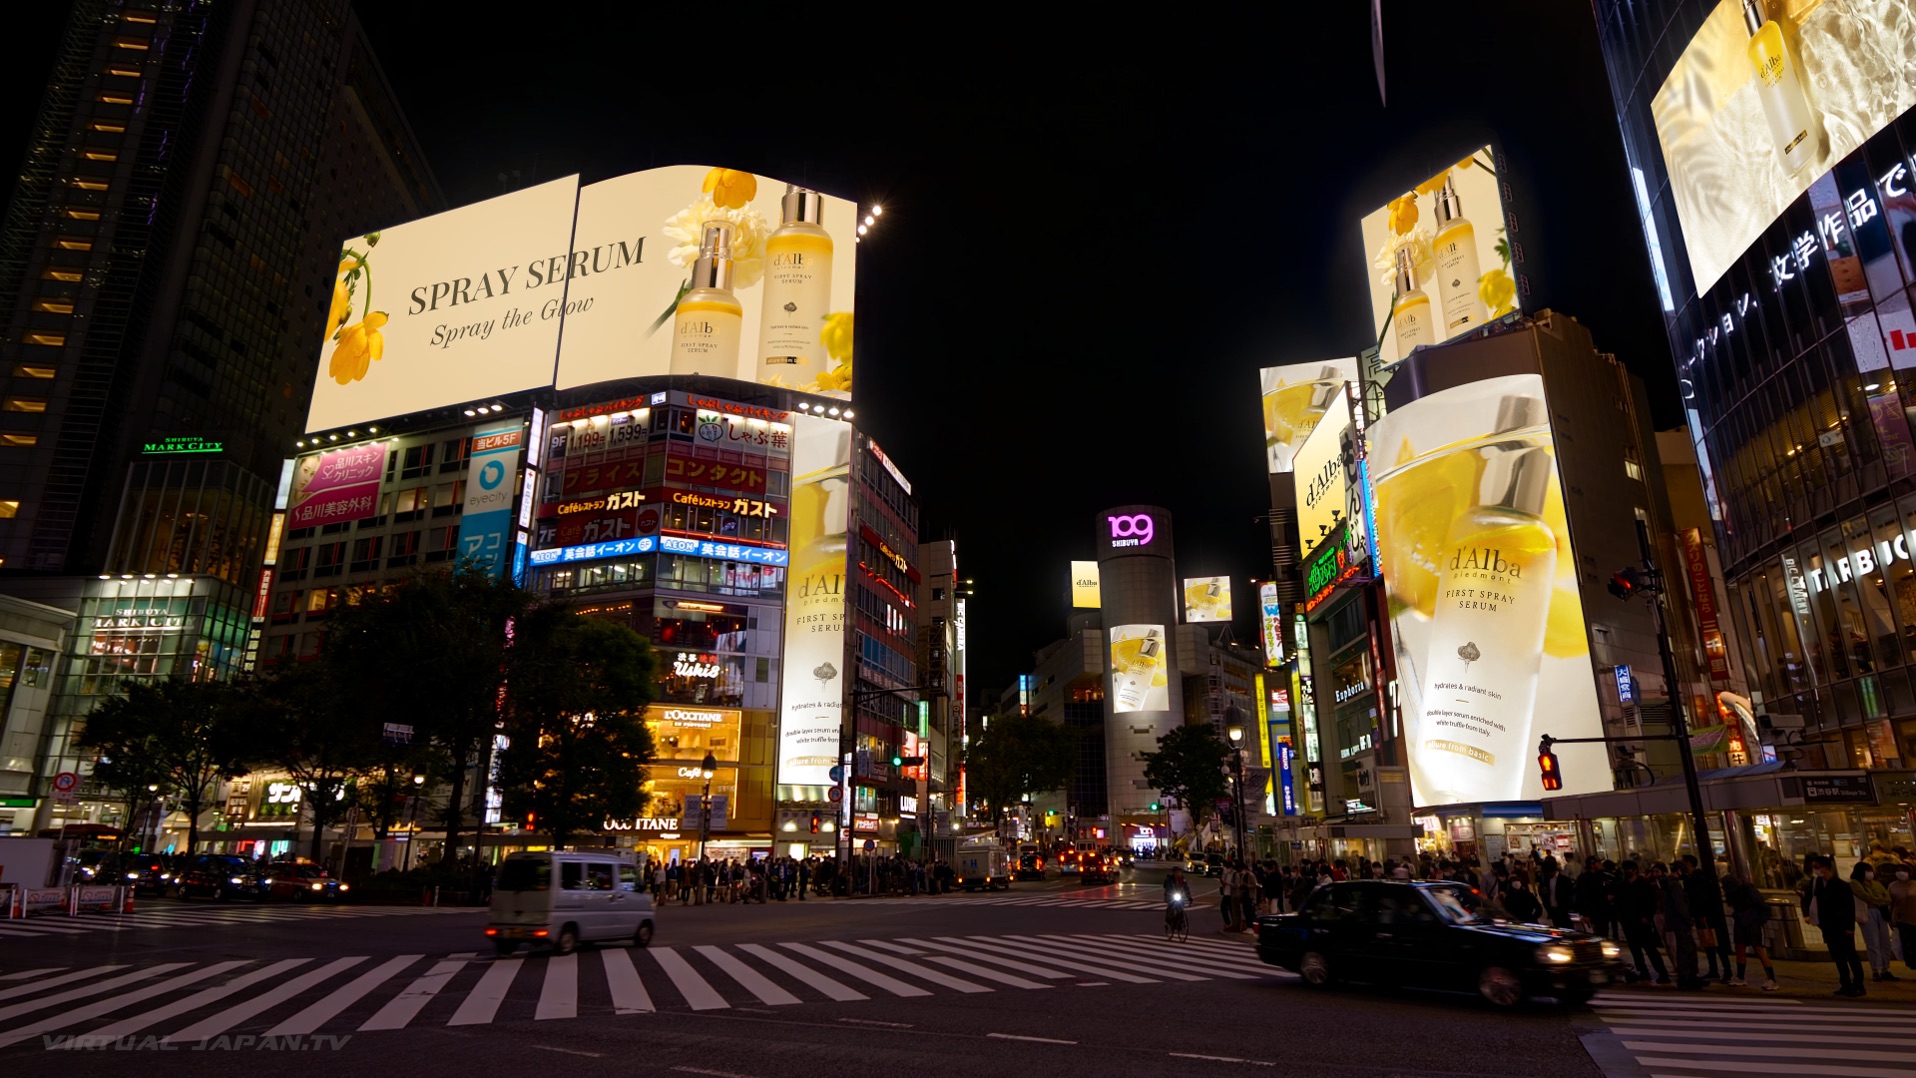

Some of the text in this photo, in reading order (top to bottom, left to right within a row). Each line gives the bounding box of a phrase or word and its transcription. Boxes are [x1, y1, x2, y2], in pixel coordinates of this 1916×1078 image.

[408, 236, 646, 315] SPRAY SERUM
[429, 297, 594, 349] Spray the Glow
[687, 394, 789, 420] しゃぶしゃぶバイキング
[477, 432, 517, 450] 当ビル5F
[551, 435, 566, 448] 9F
[729, 424, 787, 448] しゃぶ葉
[144, 442, 222, 451] MARK CITY
[335, 452, 381, 470] 品川スキン
[333, 465, 374, 482] クリニック
[567, 462, 640, 489] プライス
[667, 458, 762, 487] コンタクト
[1306, 452, 1343, 507] d'Alba
[301, 495, 372, 520] 品川美容外科
[469, 491, 508, 506] eyecity
[606, 491, 645, 511] ガスト
[733, 498, 777, 518] ガスト
[539, 528, 557, 543] 7F
[583, 517, 631, 543] ガスト
[1108, 514, 1154, 545] 109
[664, 540, 786, 562] AEON 英会話イーオン
[1112, 538, 1139, 547] SHIBUYA
[535, 551, 558, 562] AEON
[564, 542, 635, 561] 英会話イーオン
[1450, 546, 1522, 580] d'Alba
[798, 573, 846, 599] d'Al
[1454, 570, 1512, 584] piedmont
[1446, 589, 1515, 605] FIRST SPRAY
[1459, 600, 1497, 612] SERUM
[115, 608, 168, 616] SHIBUYA
[796, 613, 827, 625] FIRST
[91, 617, 196, 627] MARK CITY
[1702, 619, 1727, 673] 三千里
[673, 661, 720, 678] Ushi8
[1335, 681, 1365, 703] Euphoria
[1464, 685, 1486, 695] radiant
[1487, 691, 1501, 700] skin
[664, 710, 722, 722] L'OCCITANE
[1448, 742, 1467, 752] from
[1468, 747, 1489, 761] basic
[678, 767, 702, 778] Café
[900, 796, 917, 813] LUSH
